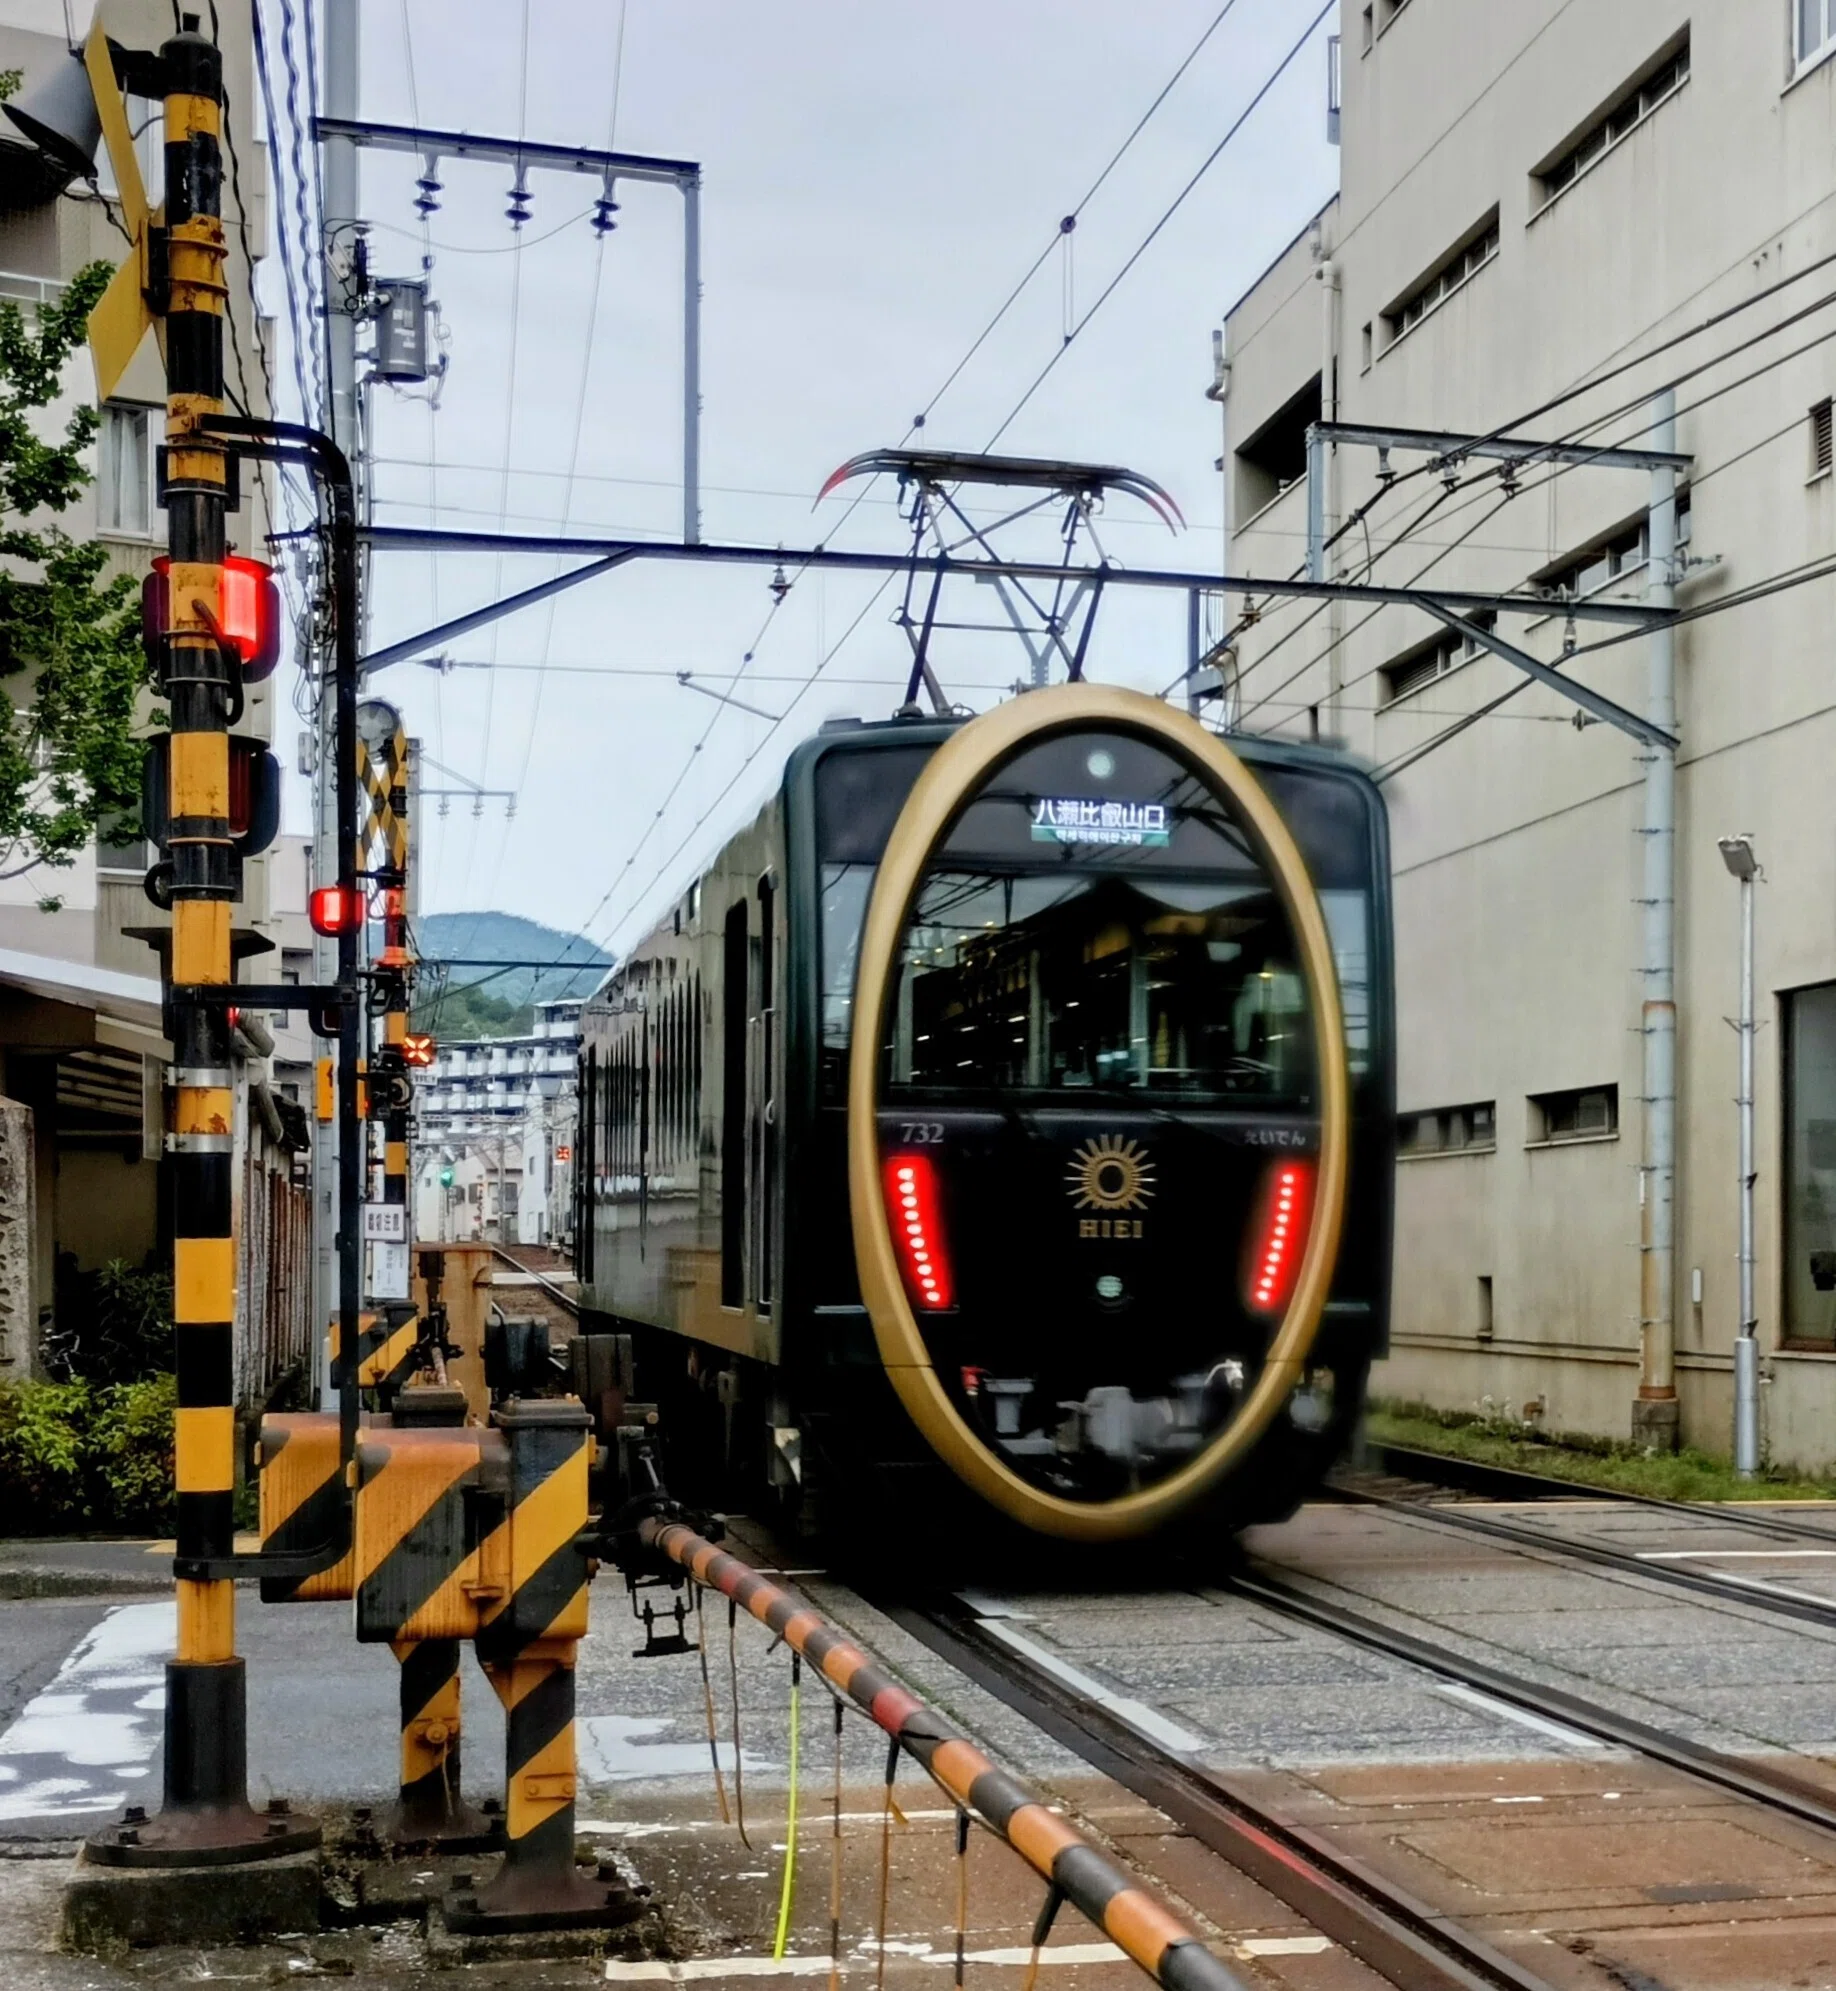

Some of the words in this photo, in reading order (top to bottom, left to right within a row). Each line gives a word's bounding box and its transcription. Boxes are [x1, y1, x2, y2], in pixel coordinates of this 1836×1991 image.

[1035, 799, 1165, 829] 八瀬比叡山口
[900, 1122, 945, 1144] 732
[1244, 1129, 1306, 1146] えいでん
[1078, 1219, 1144, 1239] HIEI
